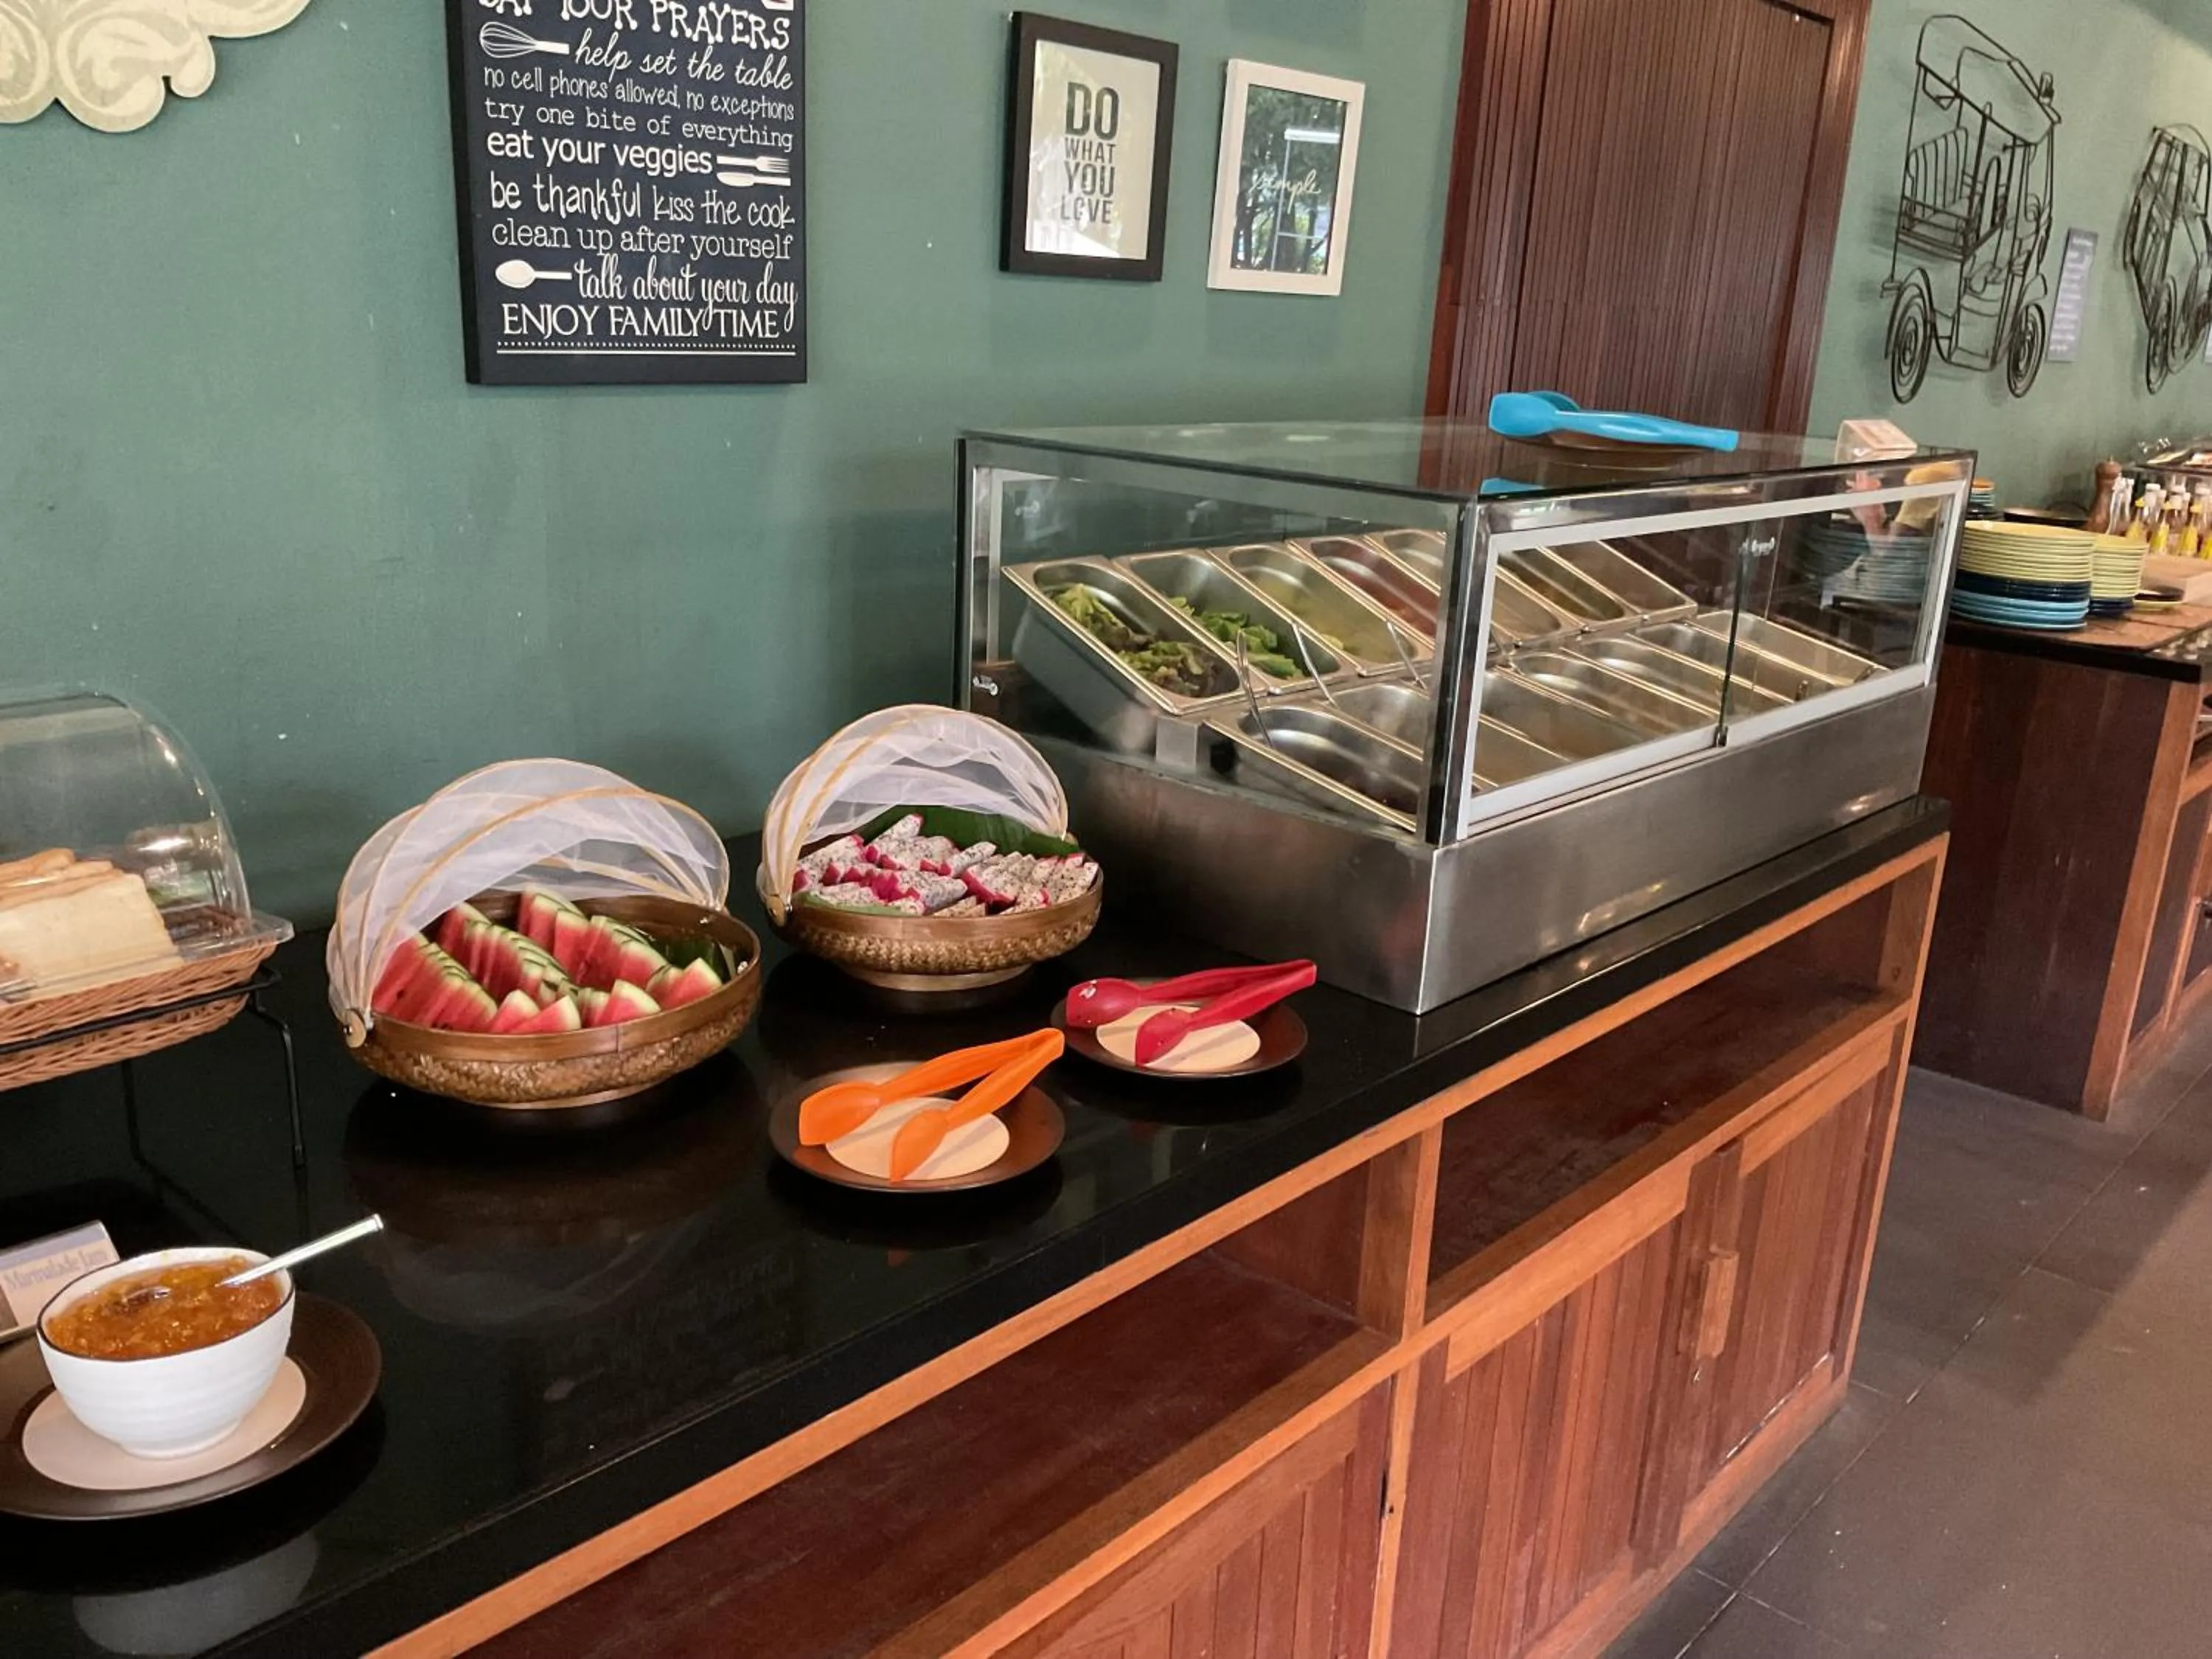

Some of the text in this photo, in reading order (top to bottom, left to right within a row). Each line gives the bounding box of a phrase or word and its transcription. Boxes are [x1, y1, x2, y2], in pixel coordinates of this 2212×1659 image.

[649, 0, 790, 49] PRAYERS
[575, 28, 793, 90] help set the table
[484, 66, 505, 88] no
[511, 67, 542, 92] cell
[549, 69, 609, 99] phones
[686, 90, 705, 111] no
[711, 94, 795, 121] exceptions
[1065, 82, 1120, 140] DO
[484, 97, 793, 152] try one bite of everything
[487, 129, 714, 177] eat your veggies
[1065, 137, 1116, 164] WHAT
[490, 170, 795, 229] be thankful kiss the cook
[1065, 161, 1115, 198] YOU
[1060, 195, 1113, 223] LOVE
[491, 218, 794, 260] clean up after yourself
[574, 253, 799, 333] talk about your day
[501, 303, 780, 340] ENJOY FAMILY TIME
